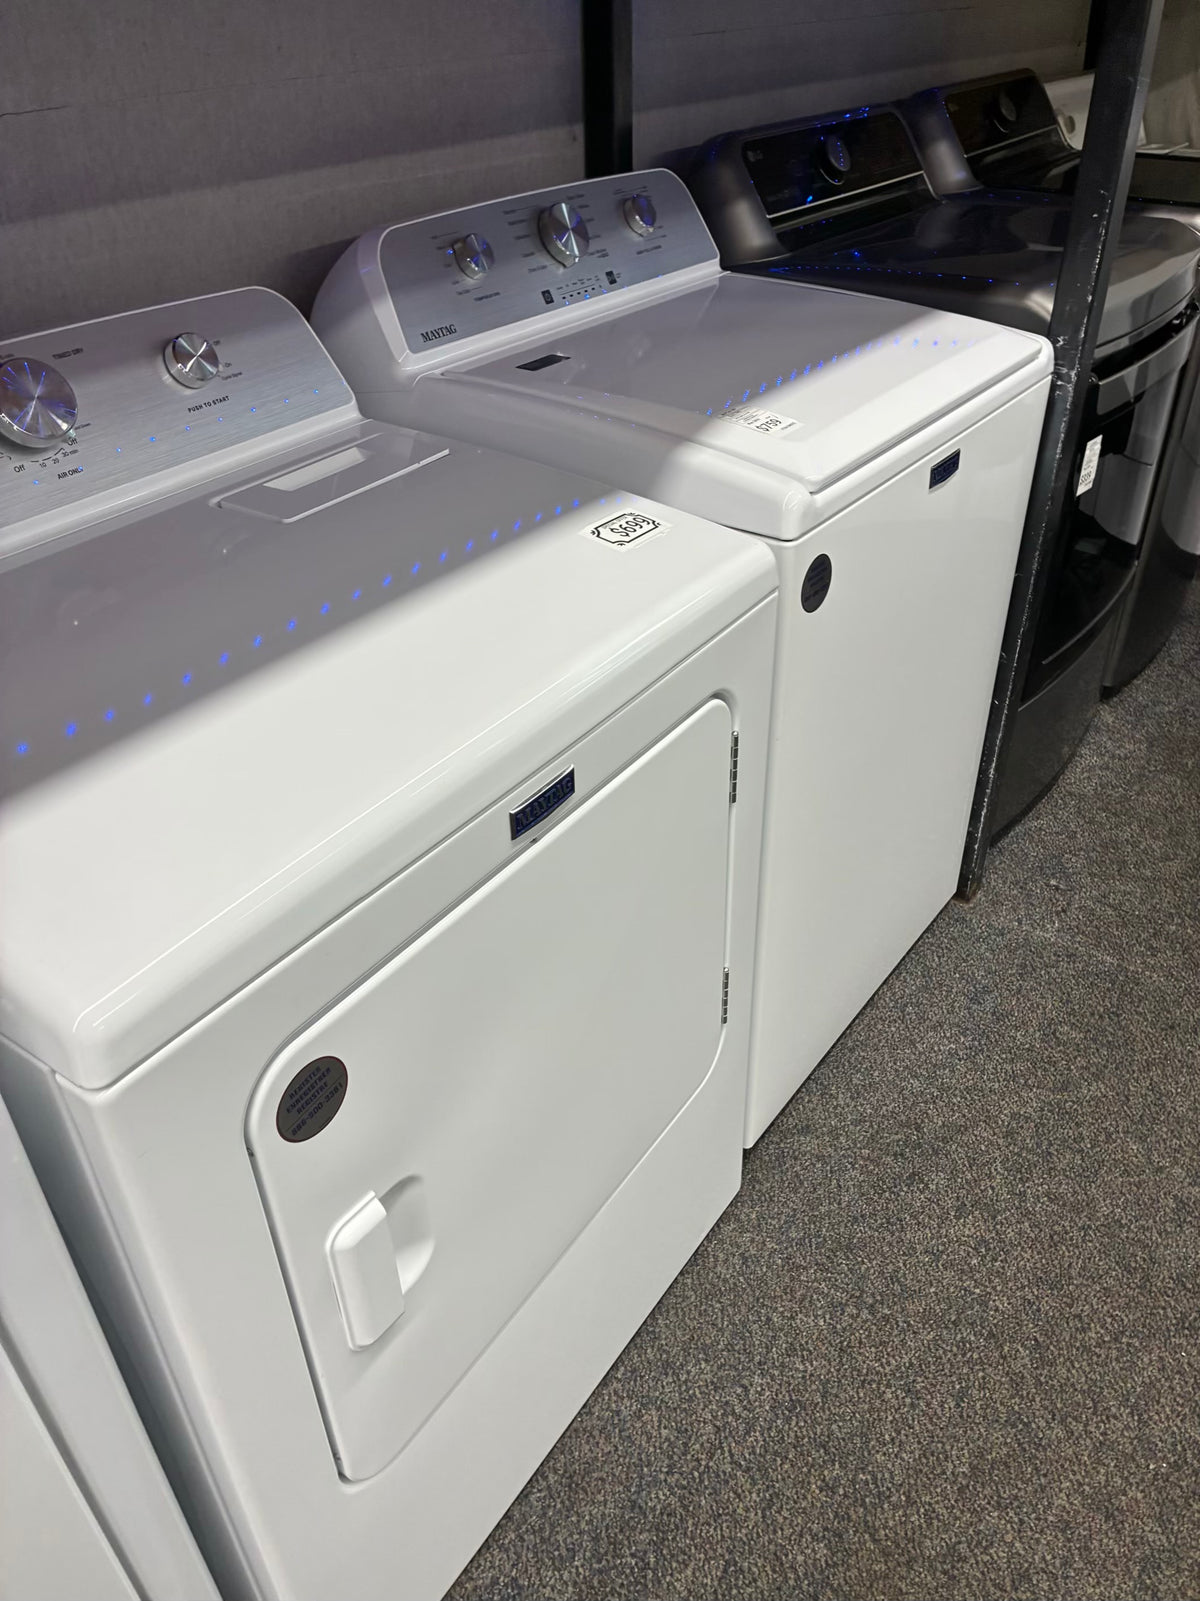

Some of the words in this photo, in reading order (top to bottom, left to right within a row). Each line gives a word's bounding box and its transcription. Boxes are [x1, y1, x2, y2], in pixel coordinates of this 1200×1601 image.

[420, 323, 457, 343] MAYTAG
[187, 404, 203, 414] PUSH
[203, 401, 212, 409] TO
[212, 395, 230, 406] START
[13, 463, 26, 474] Off
[57, 471, 68, 480] AIR
[608, 516, 651, 538] $699
